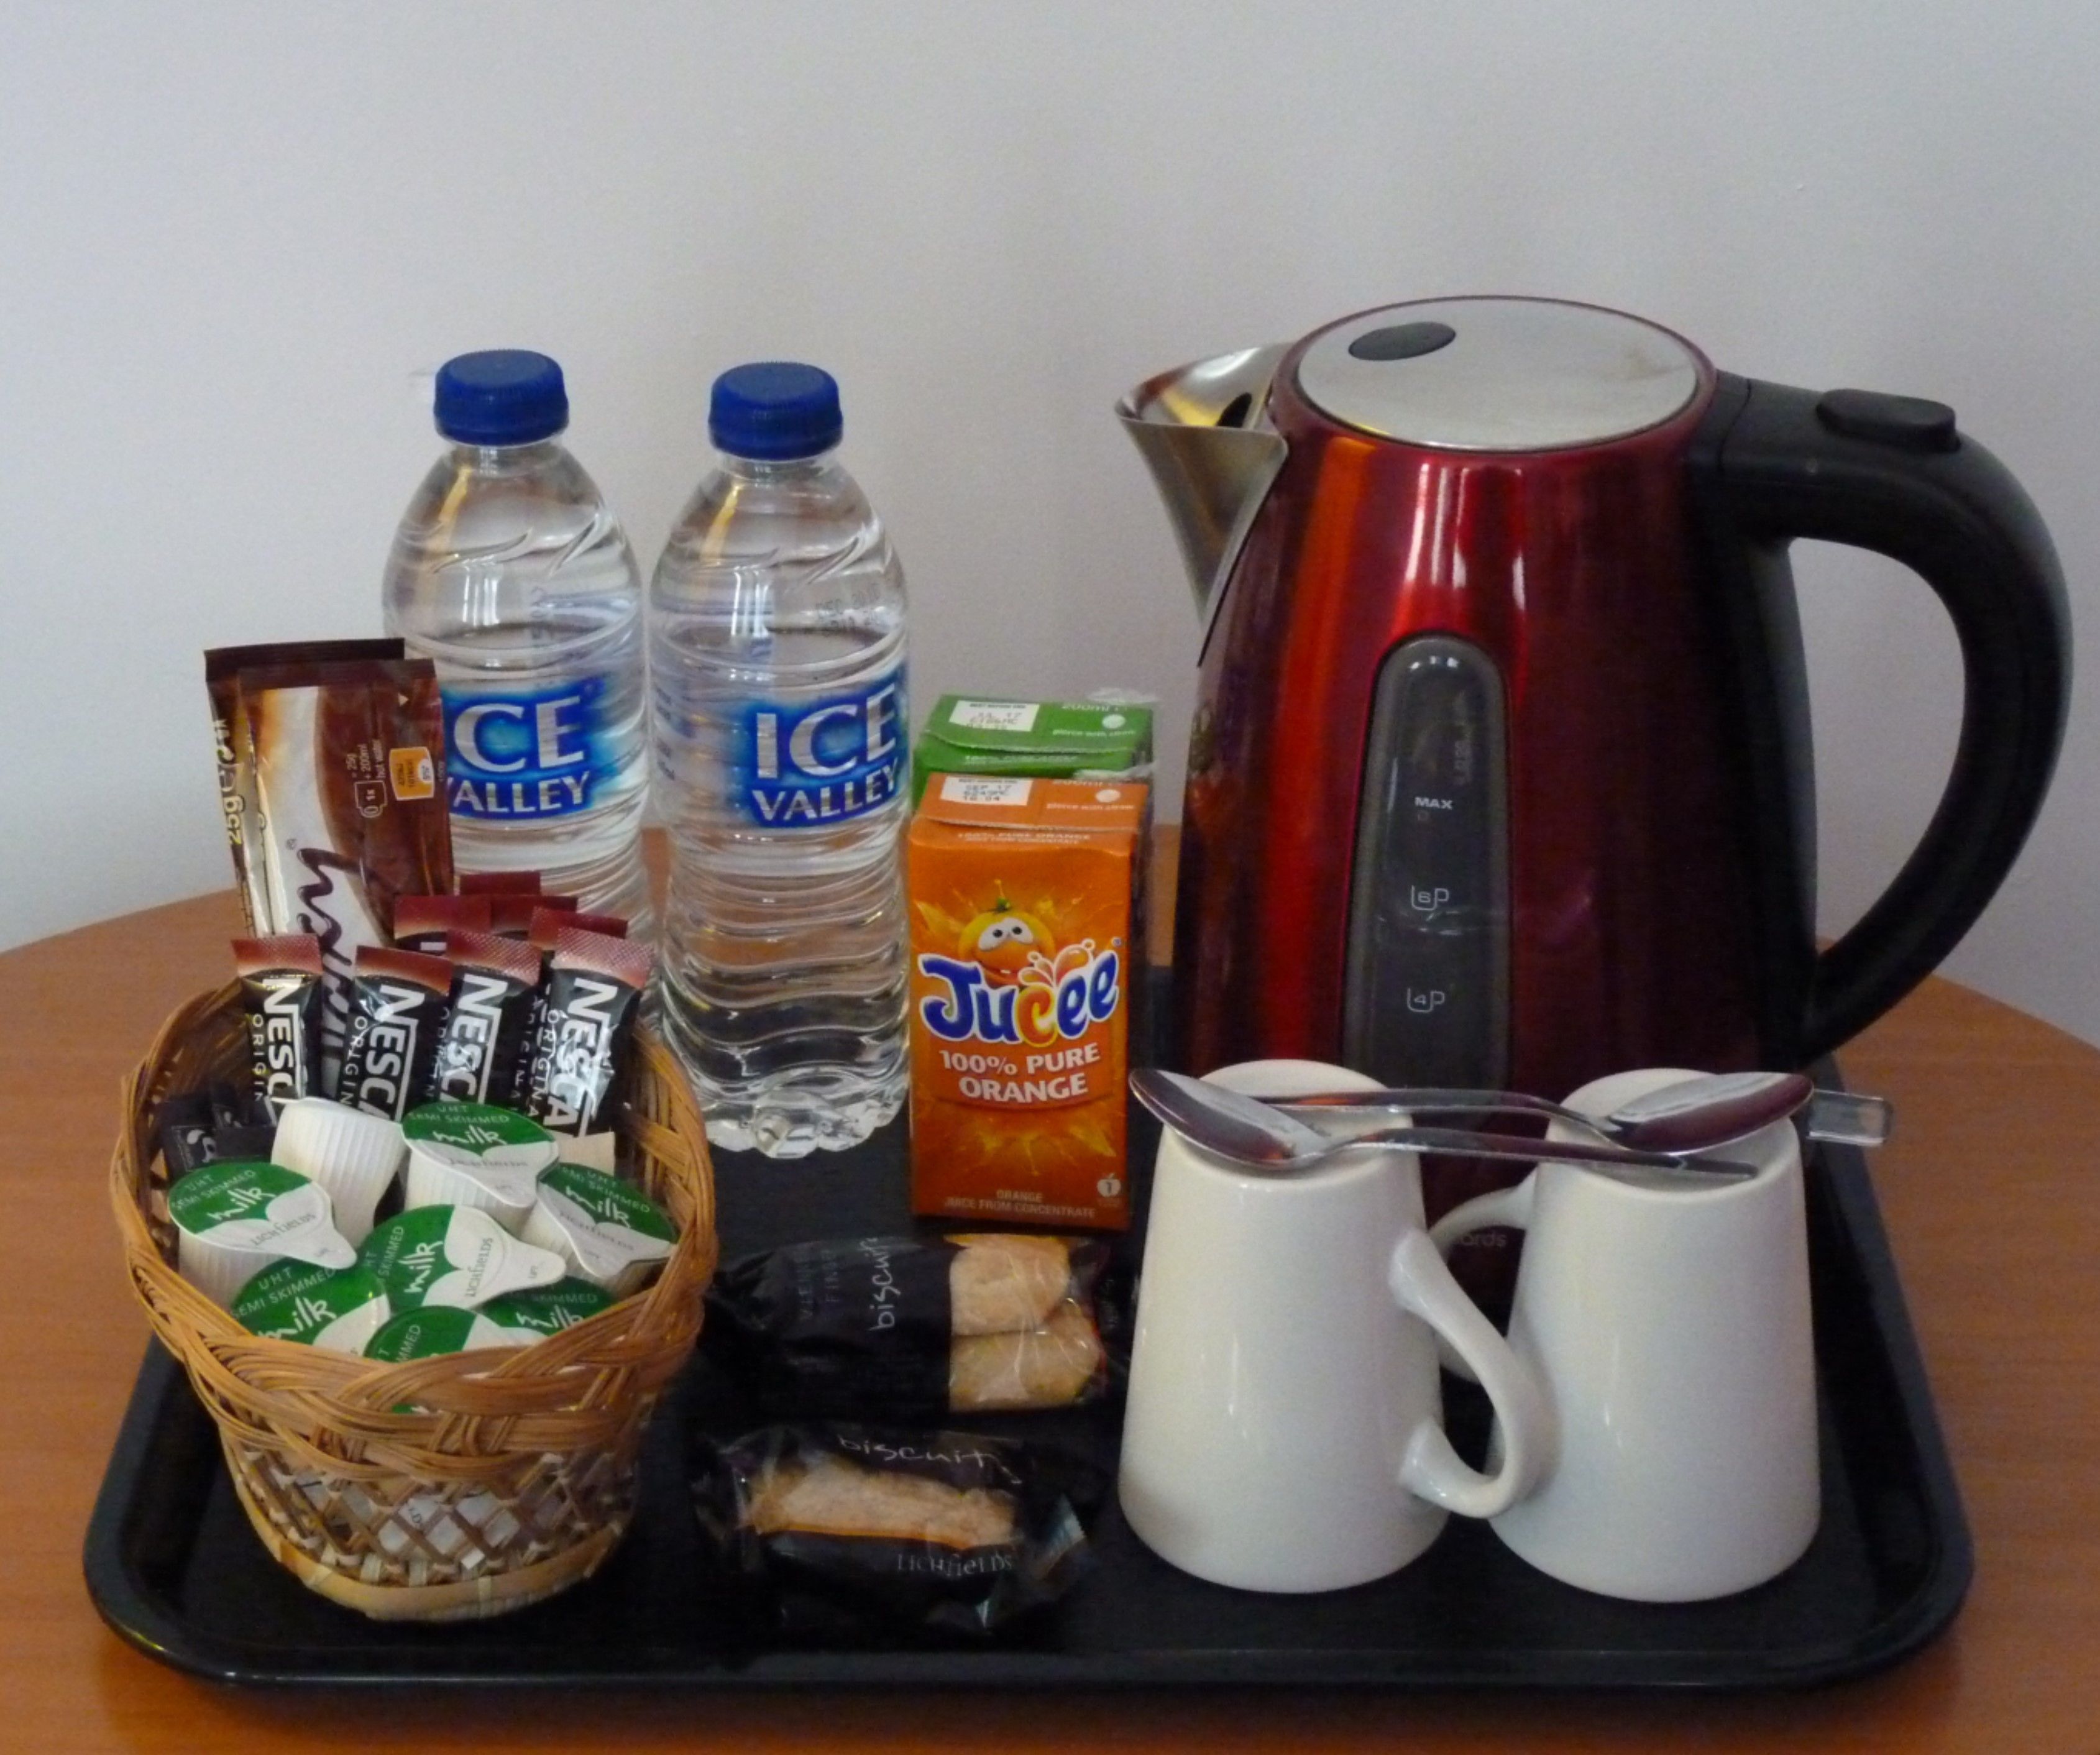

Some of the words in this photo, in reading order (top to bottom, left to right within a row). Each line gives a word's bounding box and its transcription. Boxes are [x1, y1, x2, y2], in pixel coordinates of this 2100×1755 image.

[454, 695, 584, 772] CE
[756, 682, 896, 780] ICE
[752, 756, 899, 821] VALLEY
[1414, 796, 1454, 810] MAX
[918, 950, 1119, 1048] Jucee
[252, 1014, 267, 1102] ORIGIN
[339, 1015, 368, 1106] ORIGIN
[439, 973, 508, 1104] NESC
[528, 1009, 559, 1117] ORIGINA
[543, 977, 618, 1137] NESCA
[939, 1050, 1017, 1076] 100%
[1025, 1042, 1101, 1075] PURE
[959, 1073, 1089, 1104] ORANGE
[432, 1124, 508, 1145] milk
[206, 1186, 278, 1221] milk
[565, 1185, 631, 1229] milk
[978, 1199, 1013, 1212] FROM
[1014, 1202, 1096, 1219] CONCENTRATE
[996, 1189, 1044, 1203] ORANGE
[398, 1240, 444, 1293] milk
[257, 1296, 337, 1339] milk
